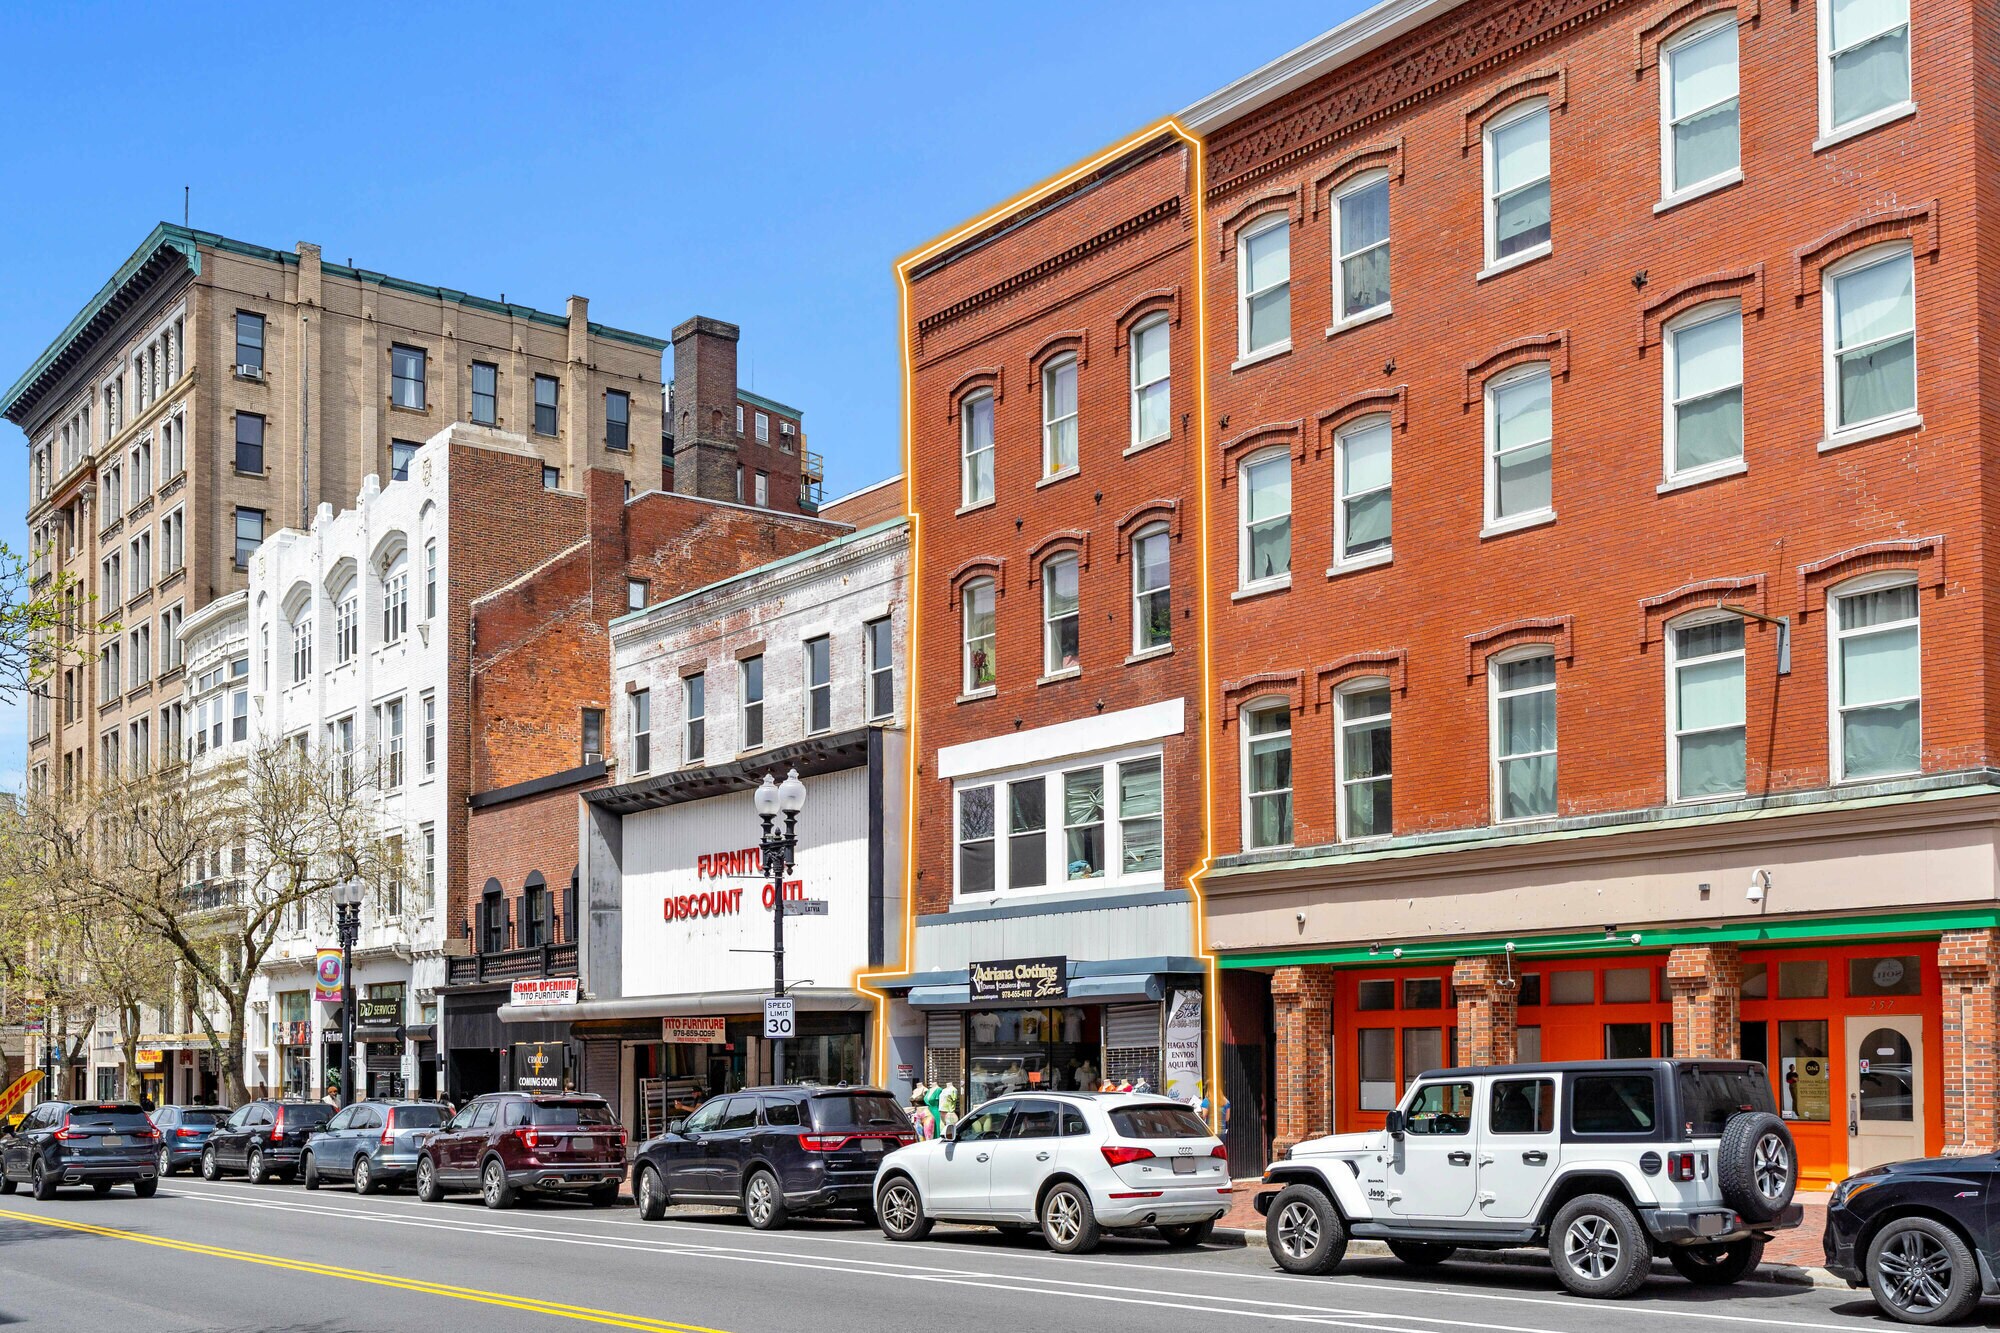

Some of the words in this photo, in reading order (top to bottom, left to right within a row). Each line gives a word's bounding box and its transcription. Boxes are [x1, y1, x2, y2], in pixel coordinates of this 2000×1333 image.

[664, 888, 743, 920] DISCOUNT
[976, 967, 1014, 981] Adriana
[1015, 963, 1058, 981] Clothing
[539, 980, 577, 992] OPENNING
[1034, 978, 1064, 998] Store
[520, 992, 534, 1000] TITO
[534, 991, 569, 999] FURNITURE
[373, 1004, 397, 1015] SERVICES
[1871, 1000, 1895, 1010] 257
[664, 1018, 681, 1030] TITO
[682, 1018, 724, 1030] FURNITURE
[768, 1018, 792, 1033] 30
[1186, 1041, 1199, 1049] SUS
[527, 1055, 549, 1064] CRIOLLO
[1171, 1051, 1195, 1059] ENVIOS
[1167, 1061, 1184, 1070] AQUI
[1185, 1060, 1199, 1068] POR
[518, 1077, 540, 1086] COMING
[541, 1077, 558, 1087] SOON
[1368, 1188, 1385, 1198] Jeep
